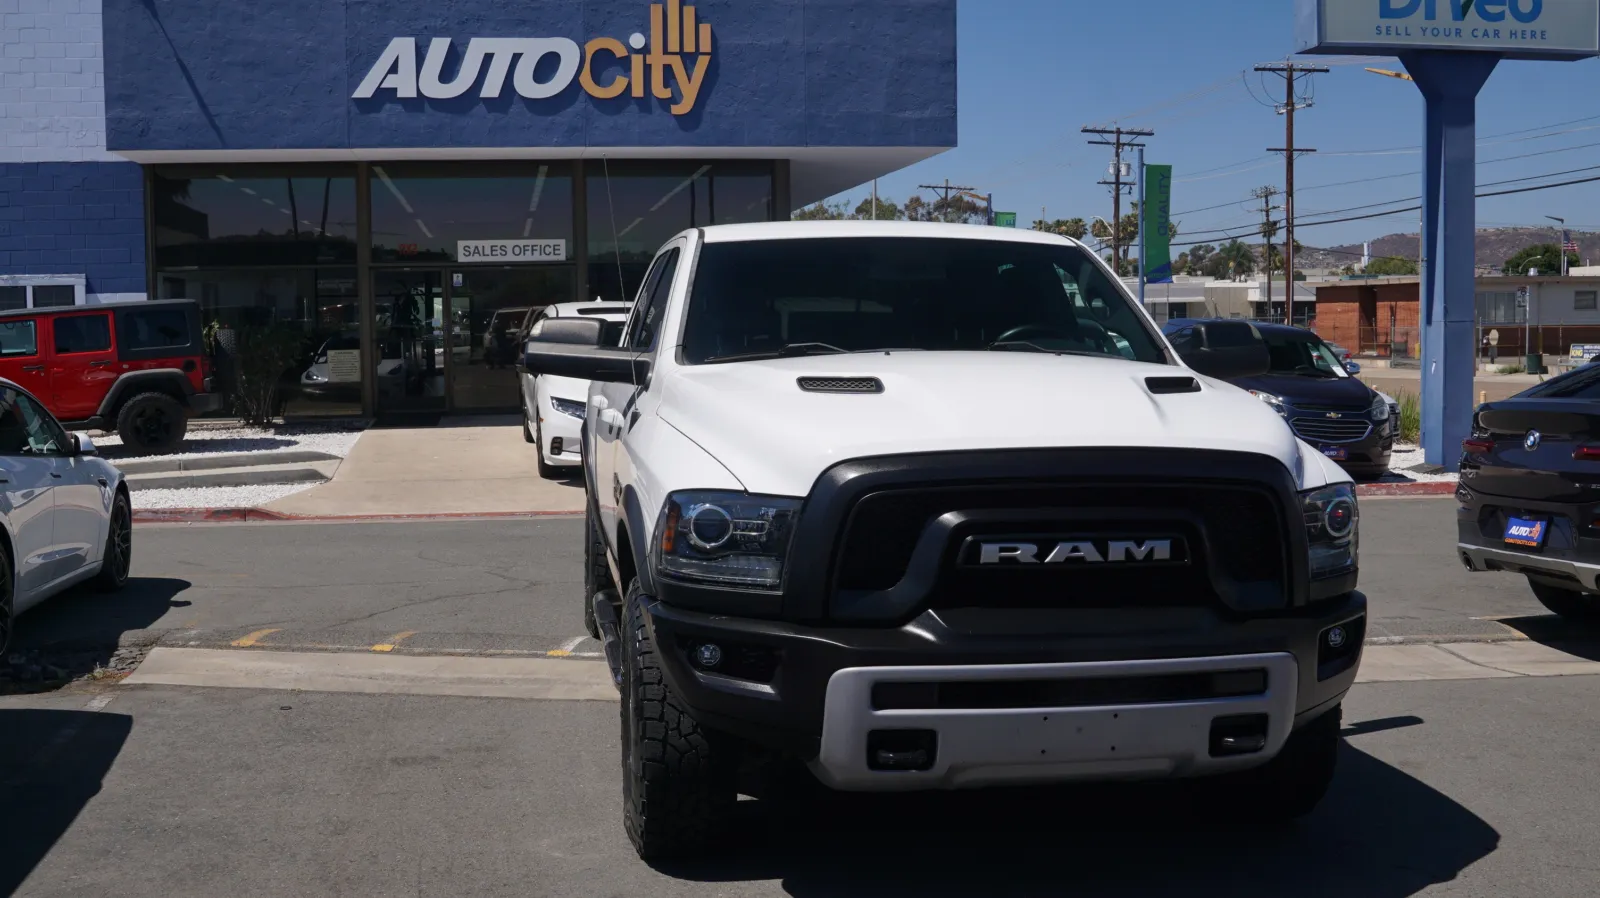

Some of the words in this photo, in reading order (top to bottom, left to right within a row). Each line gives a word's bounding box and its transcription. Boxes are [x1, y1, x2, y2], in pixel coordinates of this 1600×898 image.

[1375, 25, 1411, 36] SELL
[1420, 26, 1462, 38] YOUR
[1471, 28, 1501, 39] CAR
[1509, 29, 1547, 40] HERE
[1158, 172, 1171, 236] QUALITY
[462, 245, 508, 257] SALES
[511, 244, 562, 257] OFFICE
[979, 539, 1172, 564] RAM
